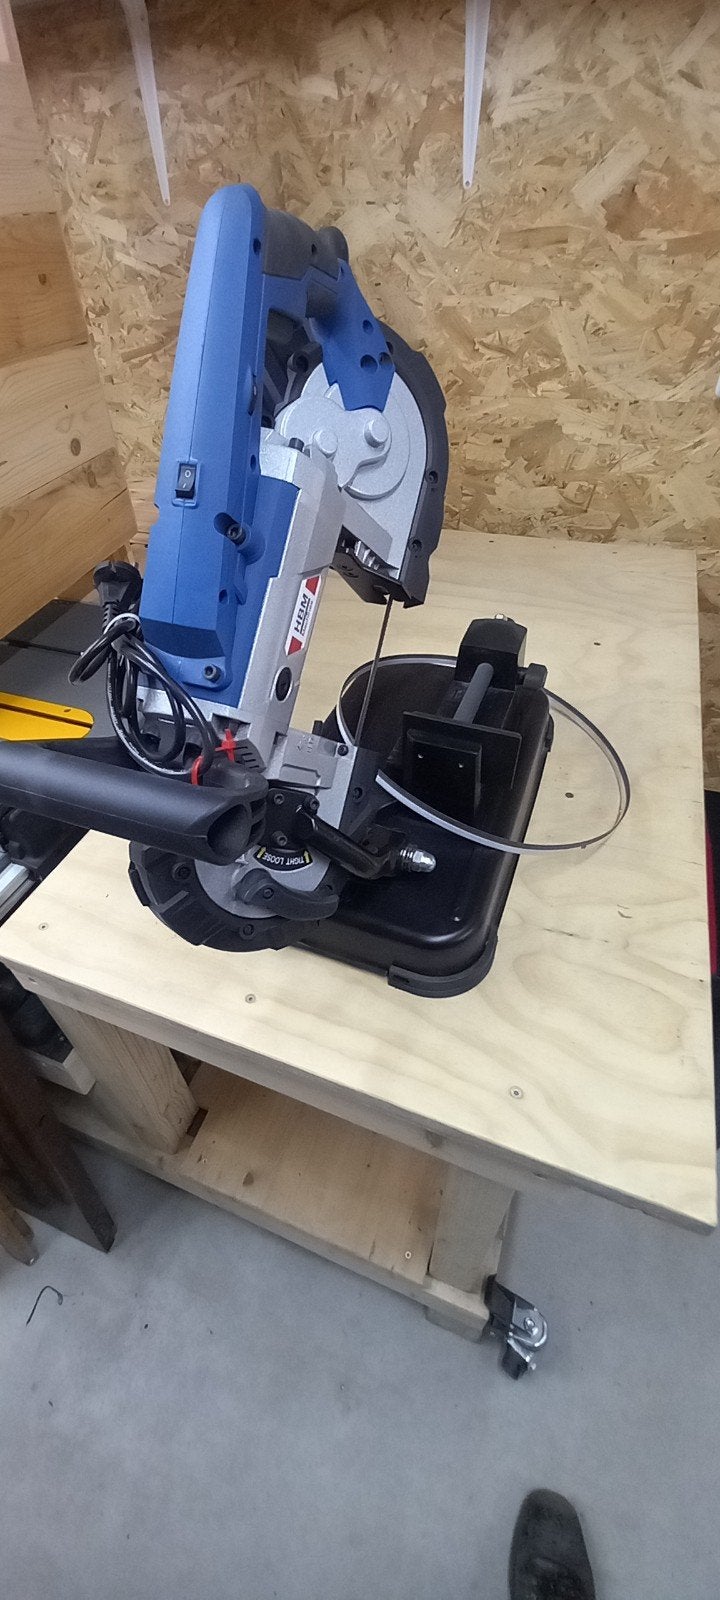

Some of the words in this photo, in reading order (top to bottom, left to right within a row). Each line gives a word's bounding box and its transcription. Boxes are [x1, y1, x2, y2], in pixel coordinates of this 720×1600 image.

[294, 593, 309, 632] HBM
[262, 852, 284, 865] LOOSE
[286, 856, 304, 865] TIGHT
